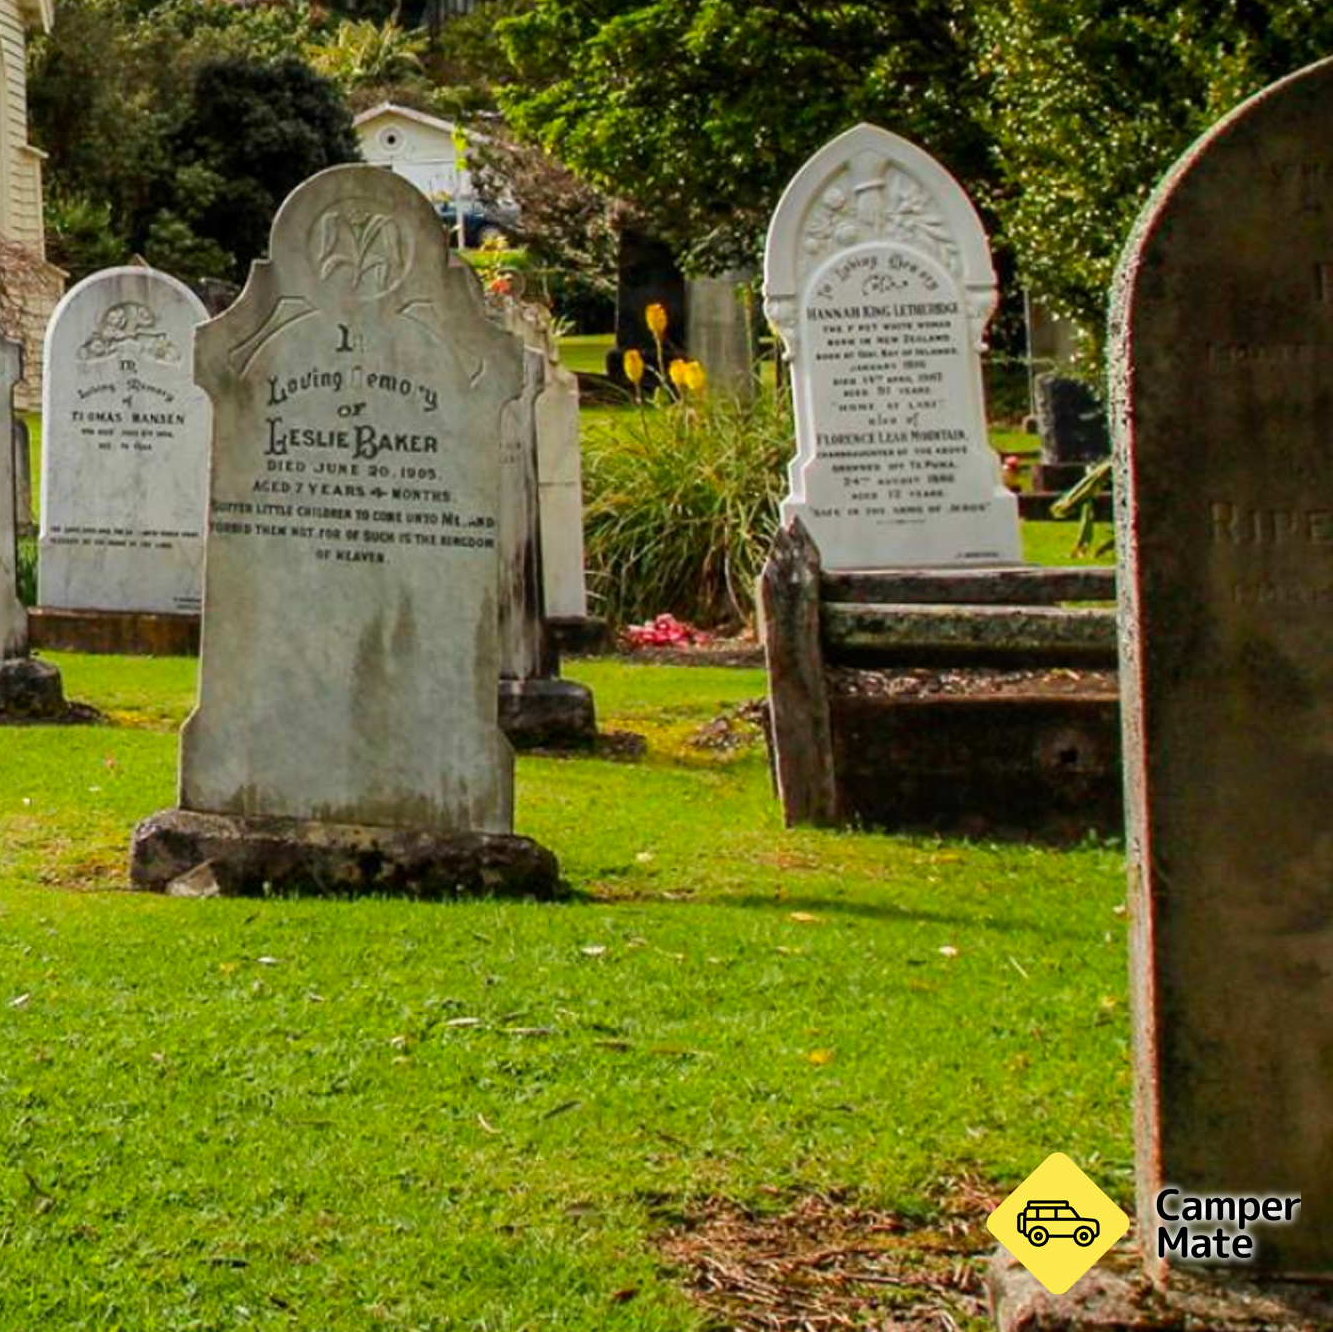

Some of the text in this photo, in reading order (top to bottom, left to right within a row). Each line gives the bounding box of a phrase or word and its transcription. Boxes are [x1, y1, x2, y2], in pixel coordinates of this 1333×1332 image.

[807, 306, 861, 321] HANNAH
[863, 305, 891, 319] KING
[847, 323, 877, 332] FRST
[267, 368, 342, 406] Loving
[353, 425, 439, 459] BAKER
[267, 459, 306, 472] DIED
[313, 462, 359, 476] JUNE
[253, 480, 290, 493] AGED
[295, 482, 304, 494] 7
[308, 483, 365, 497] YEARS
[256, 504, 293, 517] LITTLE
[297, 506, 352, 519] CHILDREN
[363, 530, 395, 543] SUCH
